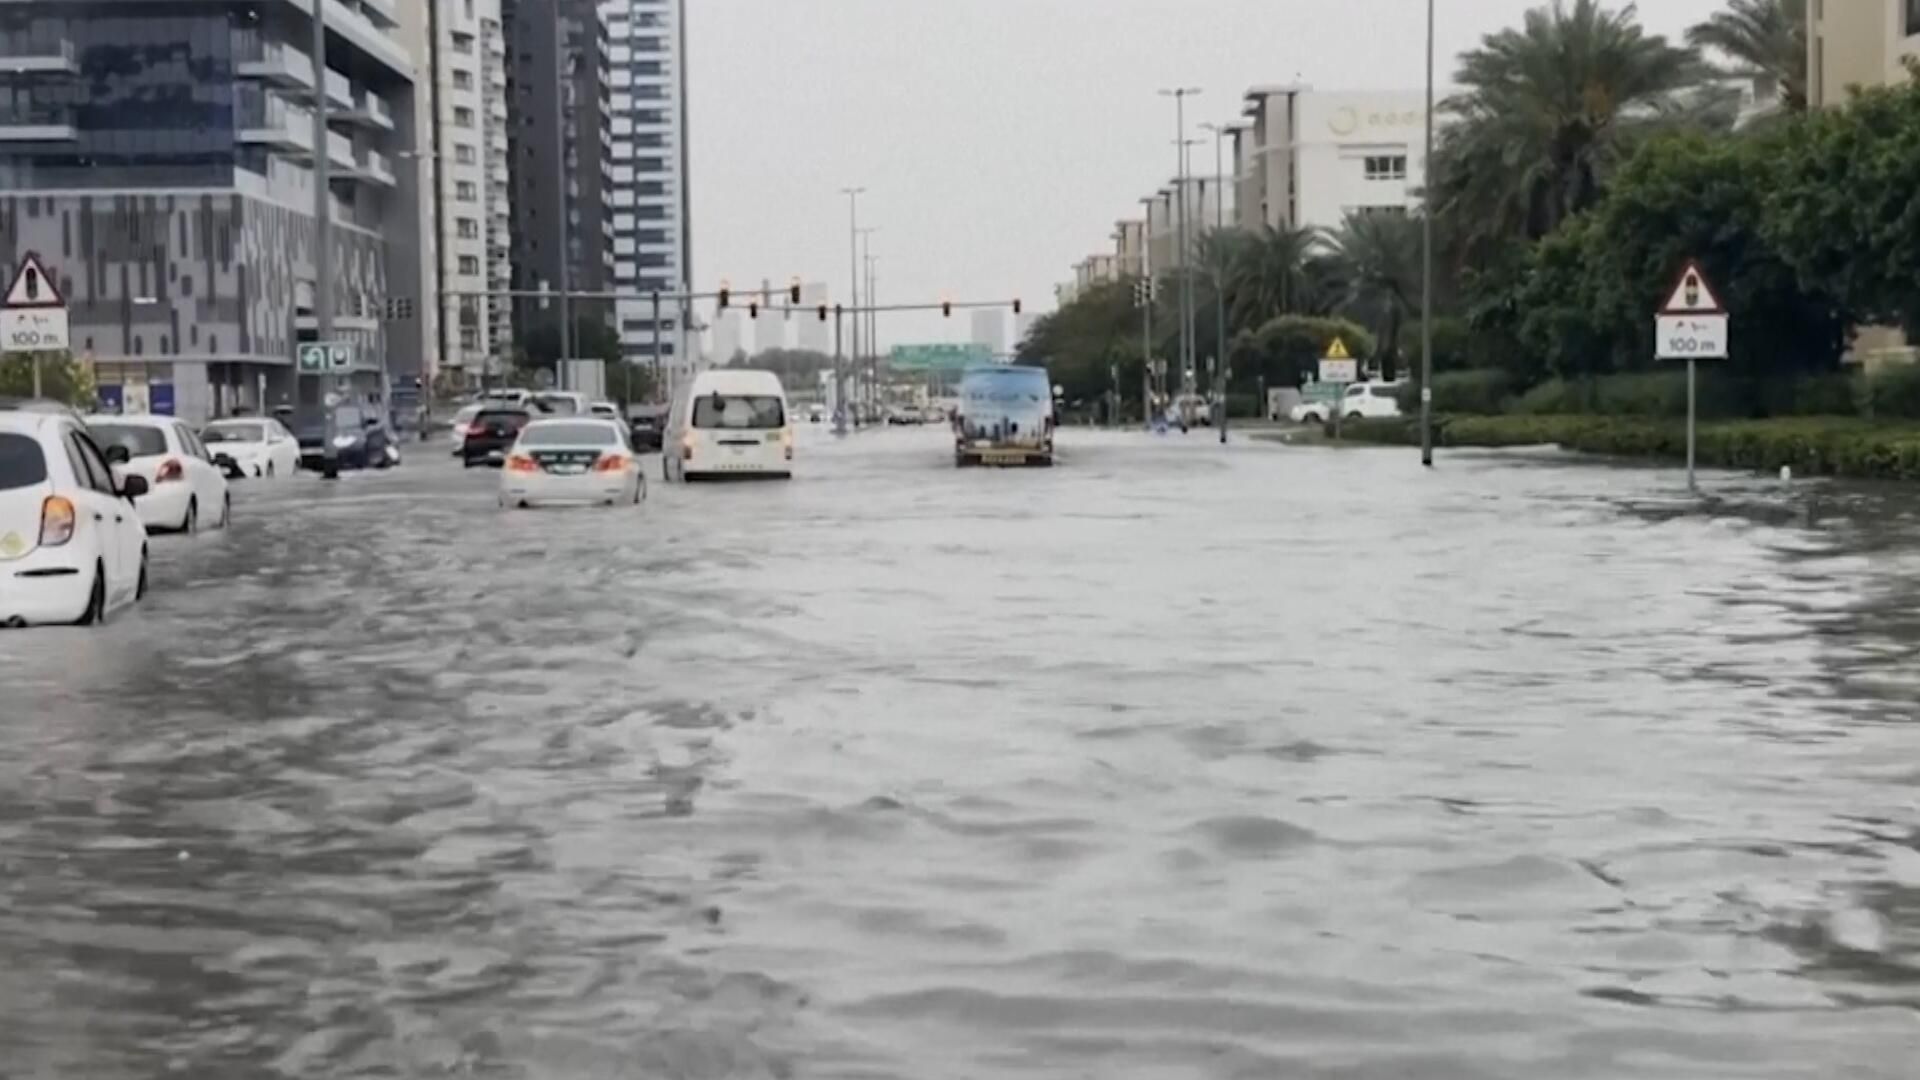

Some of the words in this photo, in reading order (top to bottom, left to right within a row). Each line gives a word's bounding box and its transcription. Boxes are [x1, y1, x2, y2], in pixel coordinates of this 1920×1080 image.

[12, 331, 40, 345] 100
[43, 334, 59, 345] m
[1669, 337, 1698, 353] 100
[1700, 341, 1716, 352] m
